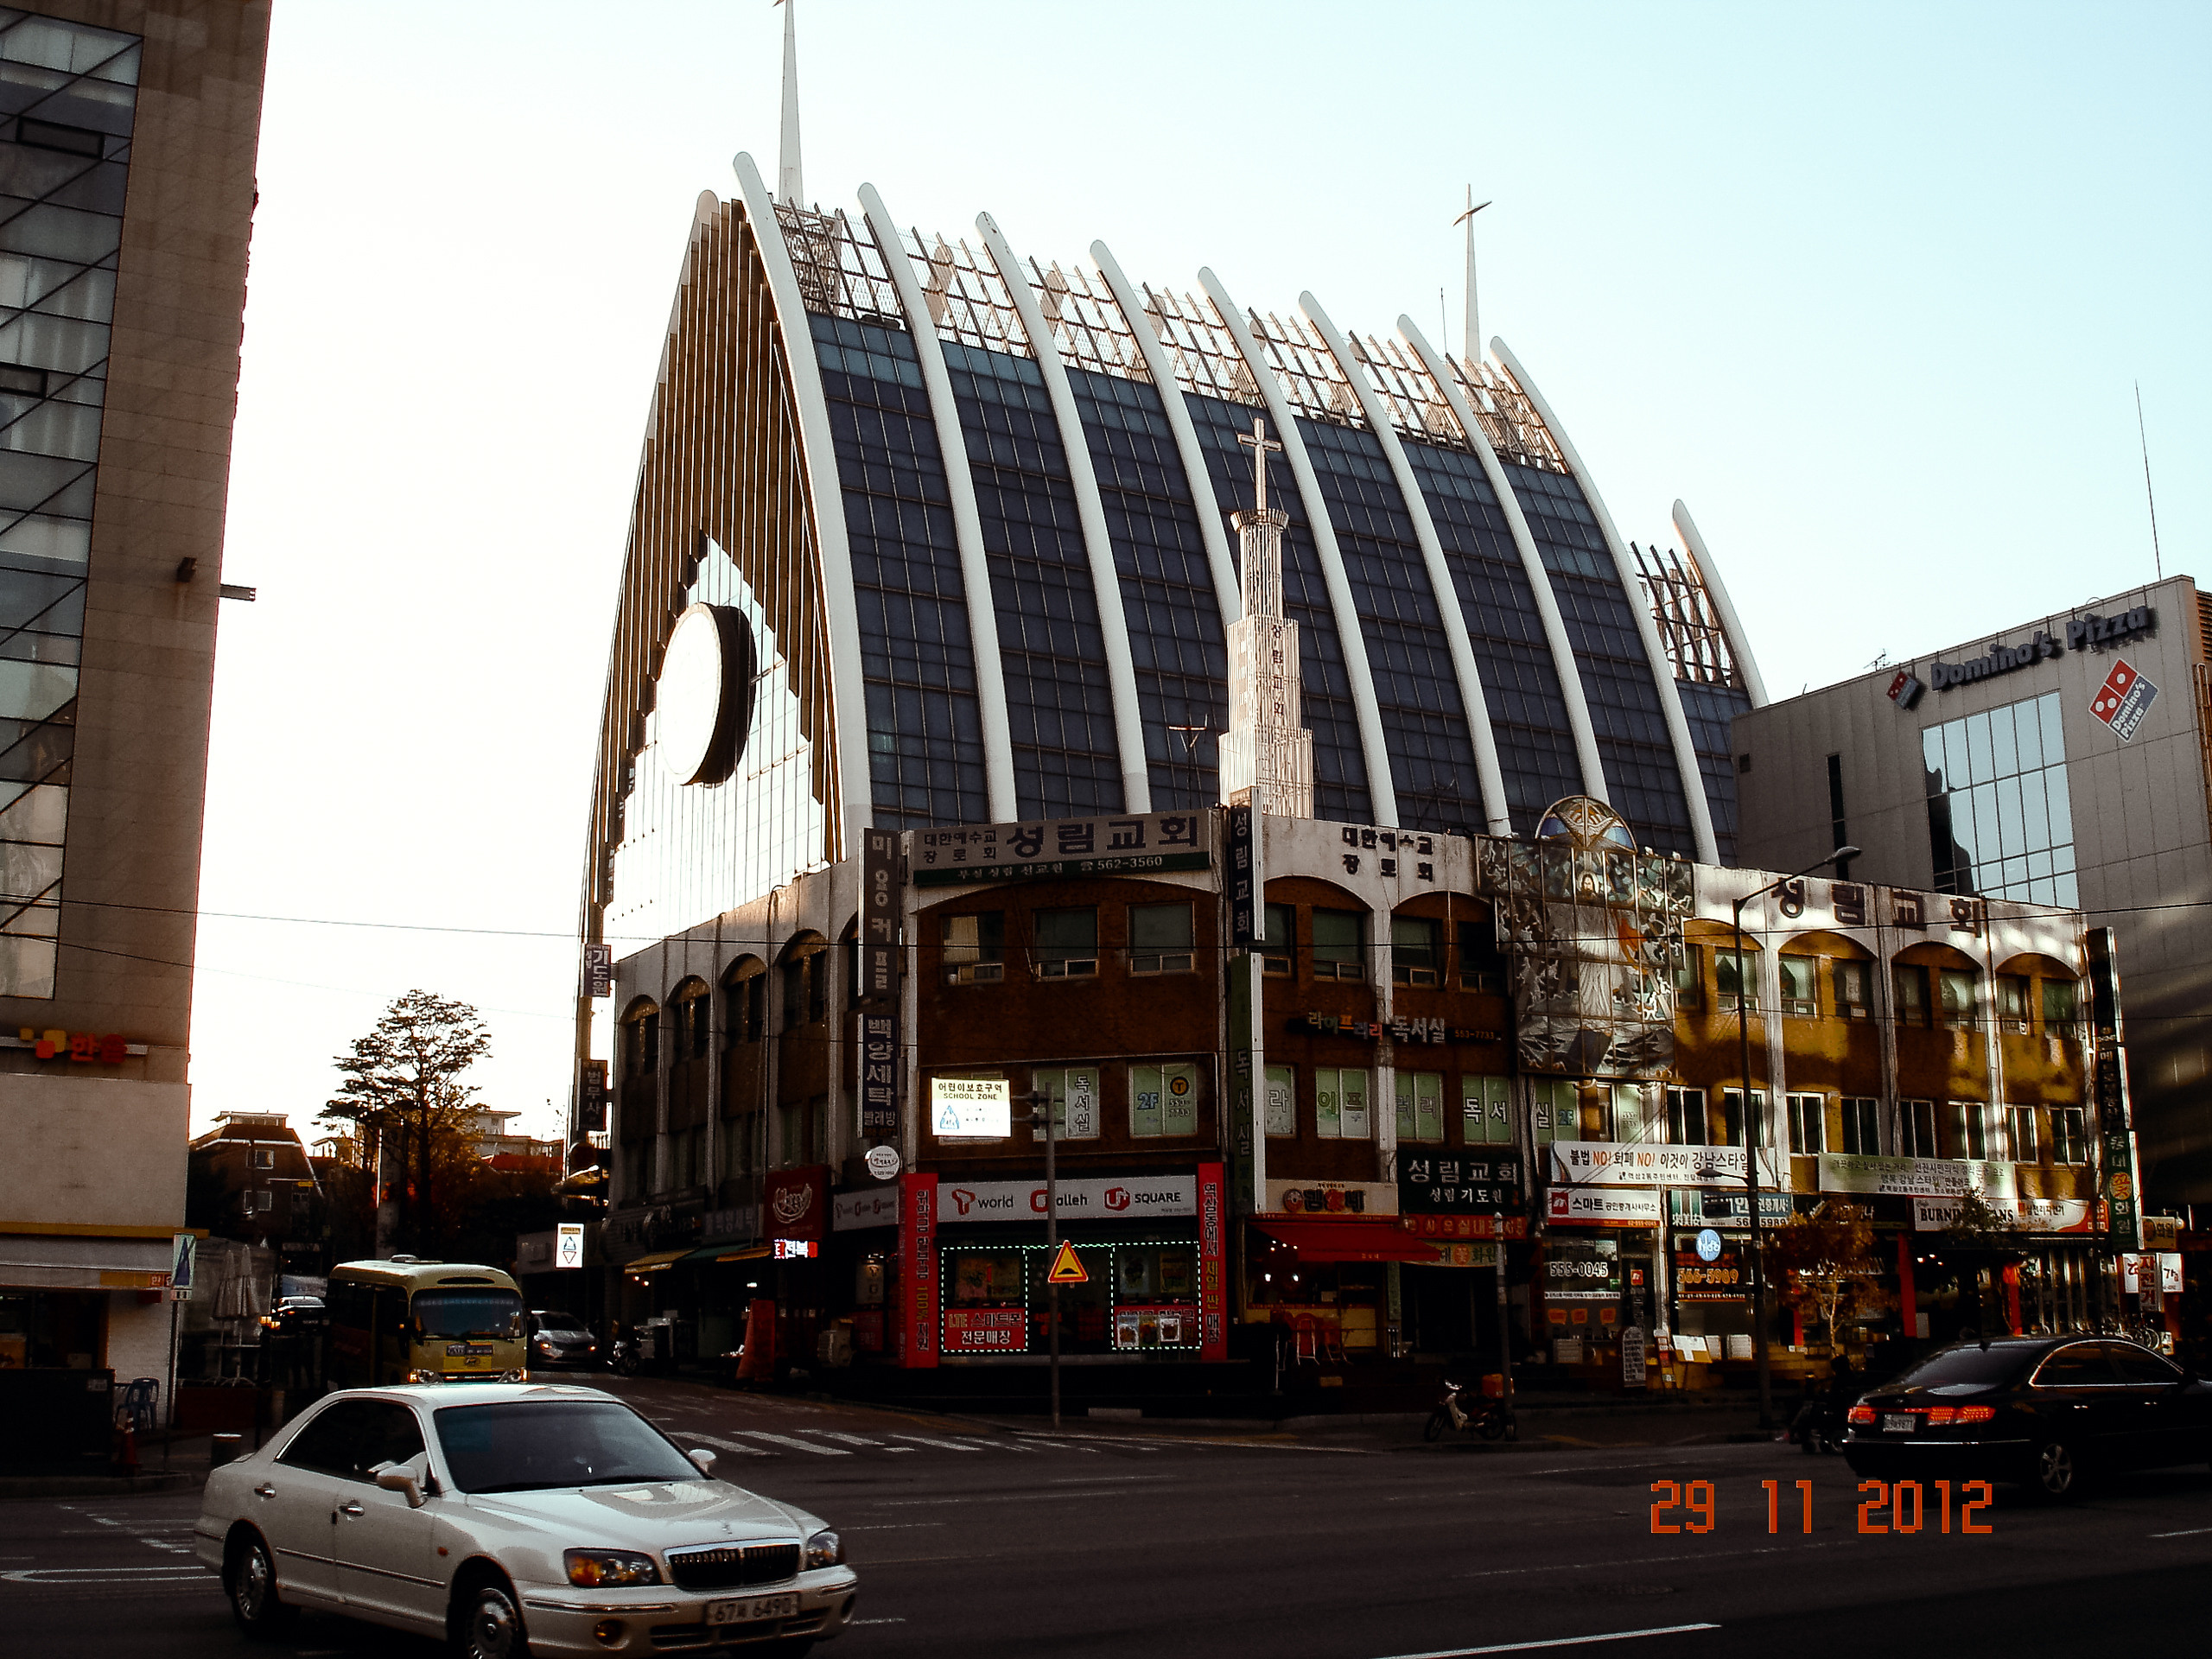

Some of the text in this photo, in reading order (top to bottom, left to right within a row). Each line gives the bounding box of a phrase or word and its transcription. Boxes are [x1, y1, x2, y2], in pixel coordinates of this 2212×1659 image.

[1930, 605, 2150, 691] Domino's Pizza
[2112, 680, 2146, 731] Domino's
[2120, 707, 2145, 739] Pizza
[924, 830, 997, 847] 대한예수교
[1007, 817, 1198, 858] 성림교회
[924, 847, 996, 864] 장로회
[1097, 855, 1163, 870] 562-3560
[1236, 812, 1249, 933] 성림교회
[1772, 876, 1982, 938] 성림교회
[1391, 1014, 1446, 1045] 독서실
[866, 1019, 894, 1106] 백양세탁
[938, 1082, 1003, 1094] 어린이보호구역
[944, 1092, 975, 1101] SCHOOL
[1075, 1076, 1091, 1133] 독서실
[1137, 1092, 1160, 1110] 2F
[1236, 1048, 1250, 1158] 독서실
[1558, 1109, 1574, 1126] 2F
[1569, 1148, 1591, 1167] 불법
[1593, 1150, 1612, 1167] NO!
[1612, 1149, 1635, 1167] 퇴폐
[1637, 1151, 1656, 1167] NO!
[1660, 1152, 1688, 1170] 이것이
[1408, 1159, 1518, 1185] 성림교회
[978, 1194, 1014, 1209] world
[1056, 1193, 1088, 1206] olleh
[1135, 1192, 1182, 1205] SQUARE
[1429, 1188, 1503, 1205] 성림 기도원
[1572, 1196, 1658, 1212] 스마트 공인중개사사무소
[1204, 1182, 1218, 1256] 역삼동에서
[1205, 1260, 1218, 1290] 제일
[1549, 1261, 1609, 1279] 555-0045
[1676, 1267, 1739, 1286] 566-5989
[2139, 1255, 2156, 1305] 자전거
[916, 1286, 929, 1320] 100%
[949, 1312, 1023, 1329] LTE 스마트폰
[1205, 1313, 1220, 1344] 매장
[961, 1330, 1011, 1346] 전문매장
